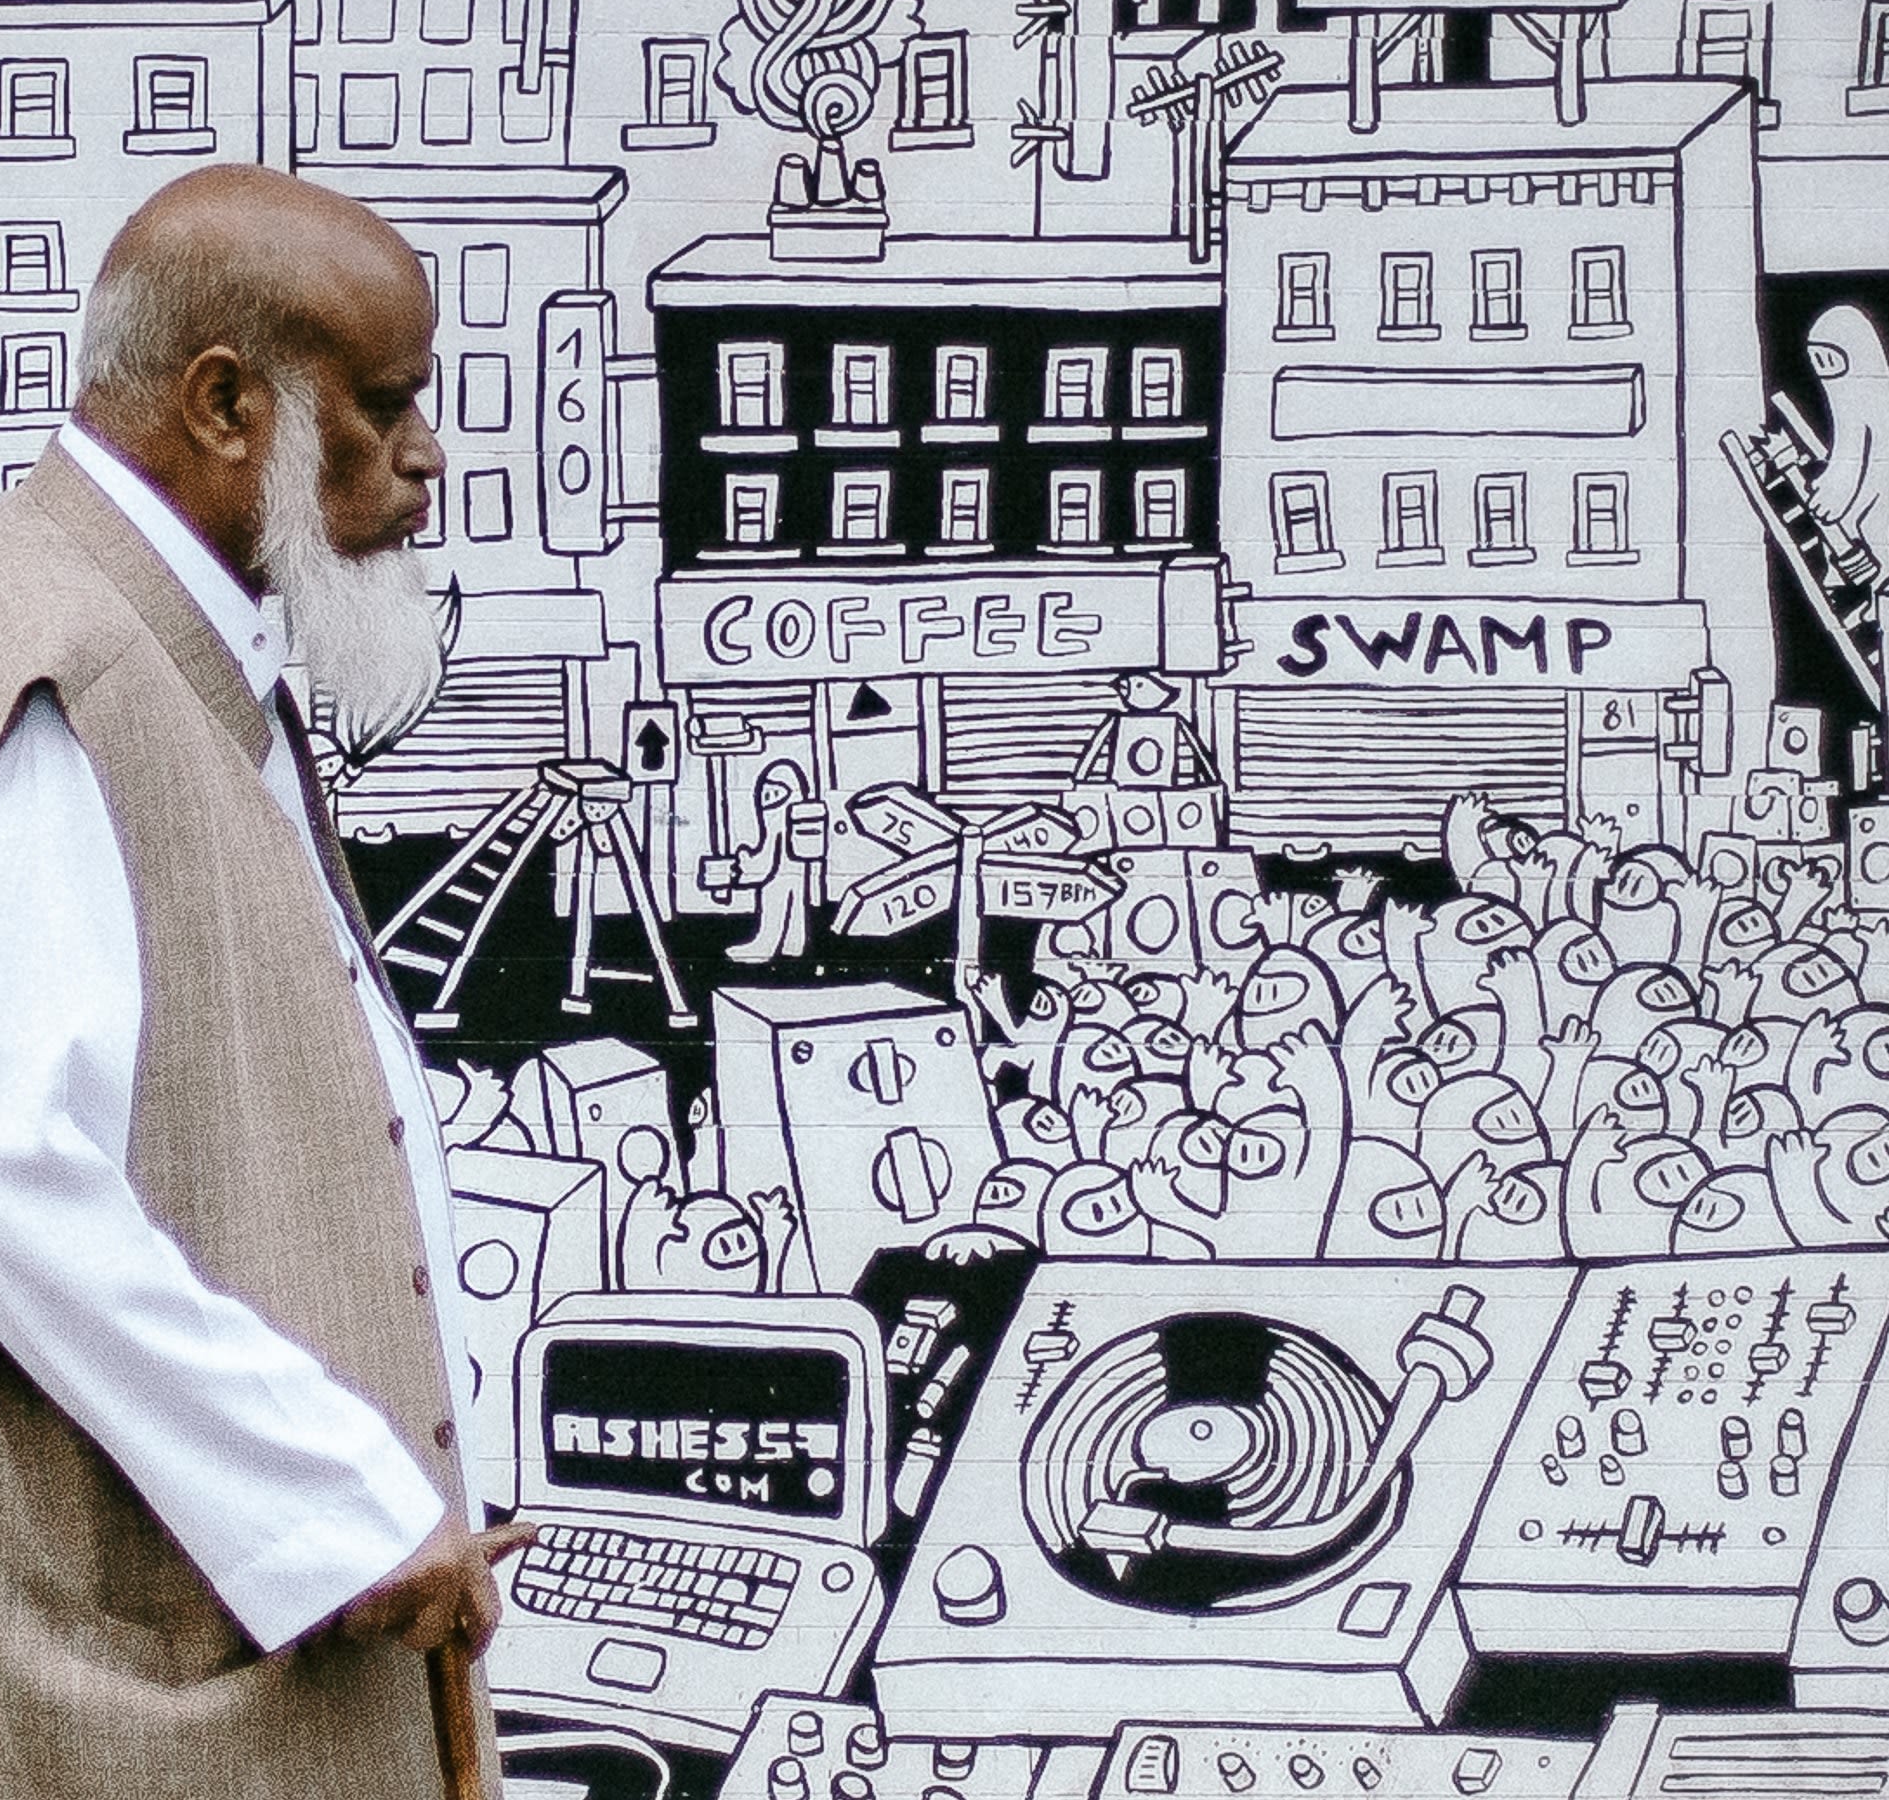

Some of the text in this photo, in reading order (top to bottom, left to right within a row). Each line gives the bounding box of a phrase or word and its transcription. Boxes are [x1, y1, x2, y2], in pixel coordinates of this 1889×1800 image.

[556, 327, 591, 496] 160
[703, 591, 1102, 666] COFFEE
[1276, 611, 1612, 678] SWAMP
[1602, 699, 1635, 731] 81
[881, 884, 936, 925] 120
